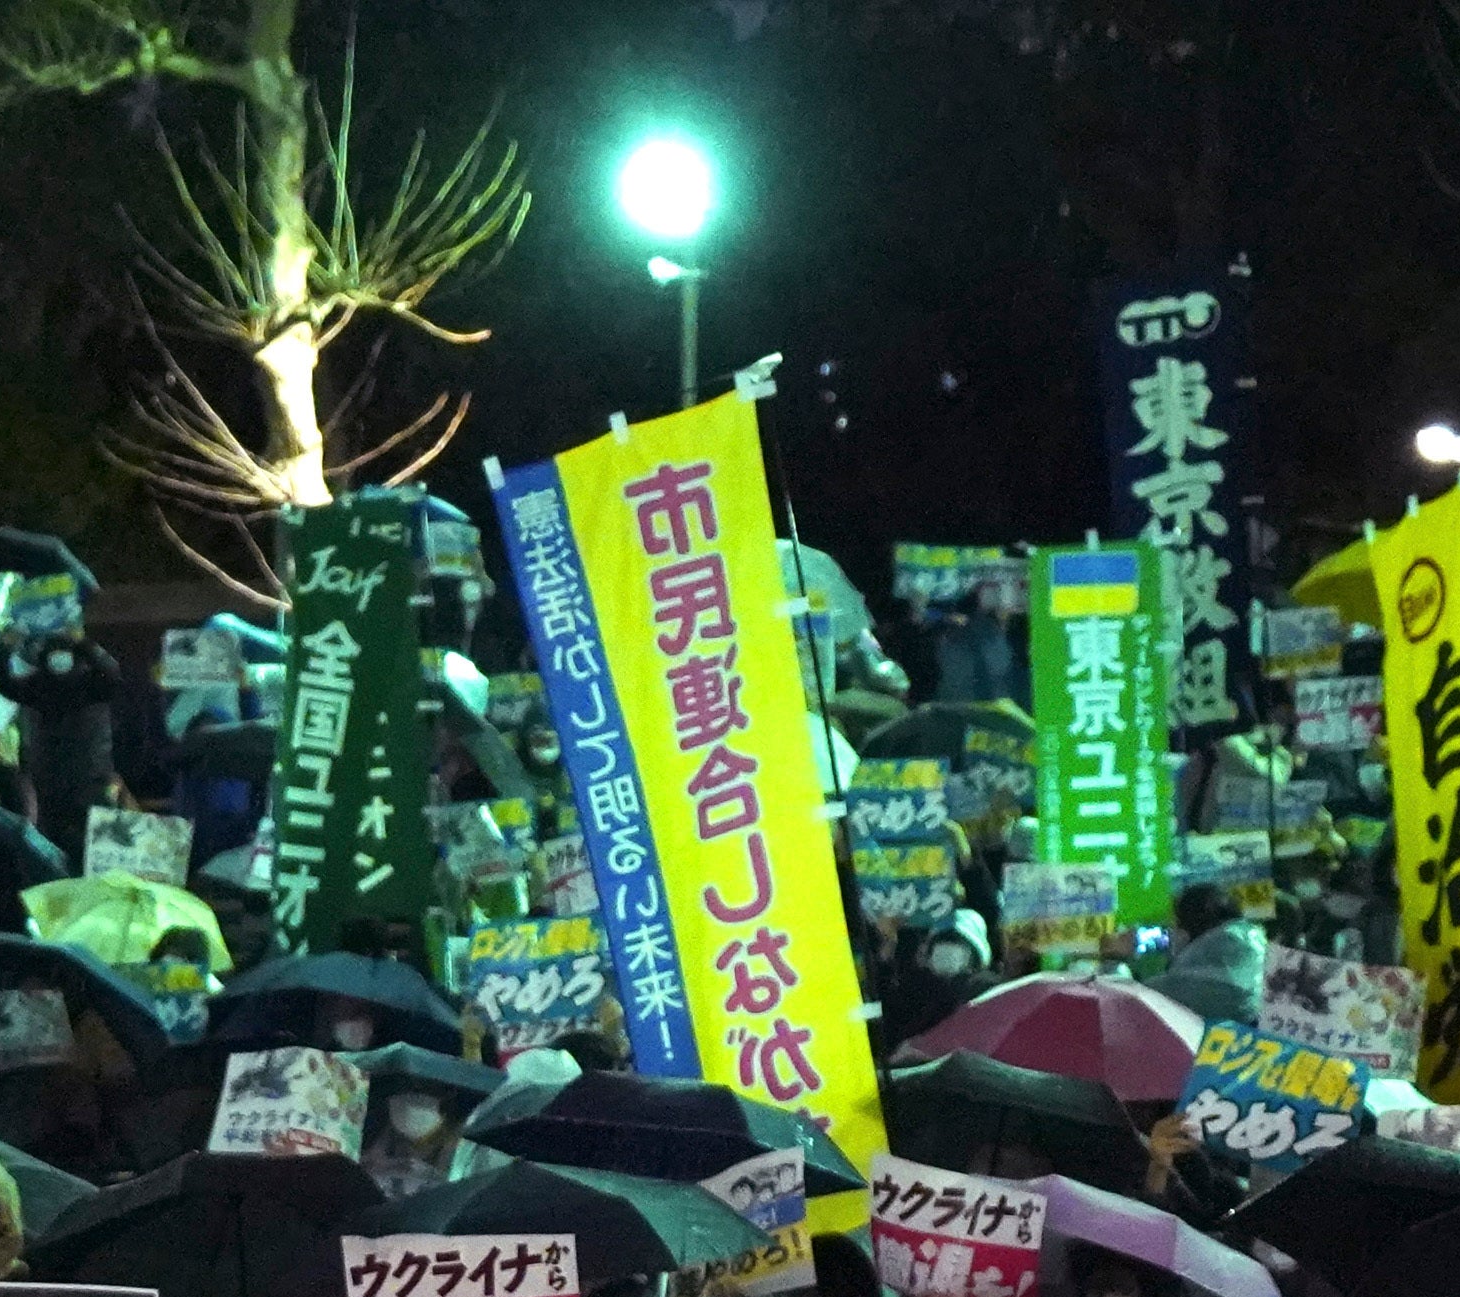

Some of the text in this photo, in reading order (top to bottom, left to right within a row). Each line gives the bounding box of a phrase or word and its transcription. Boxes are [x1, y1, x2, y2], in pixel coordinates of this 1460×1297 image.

[478, 955, 606, 1022] やめろ
[873, 1173, 1042, 1246] ウクライナから
